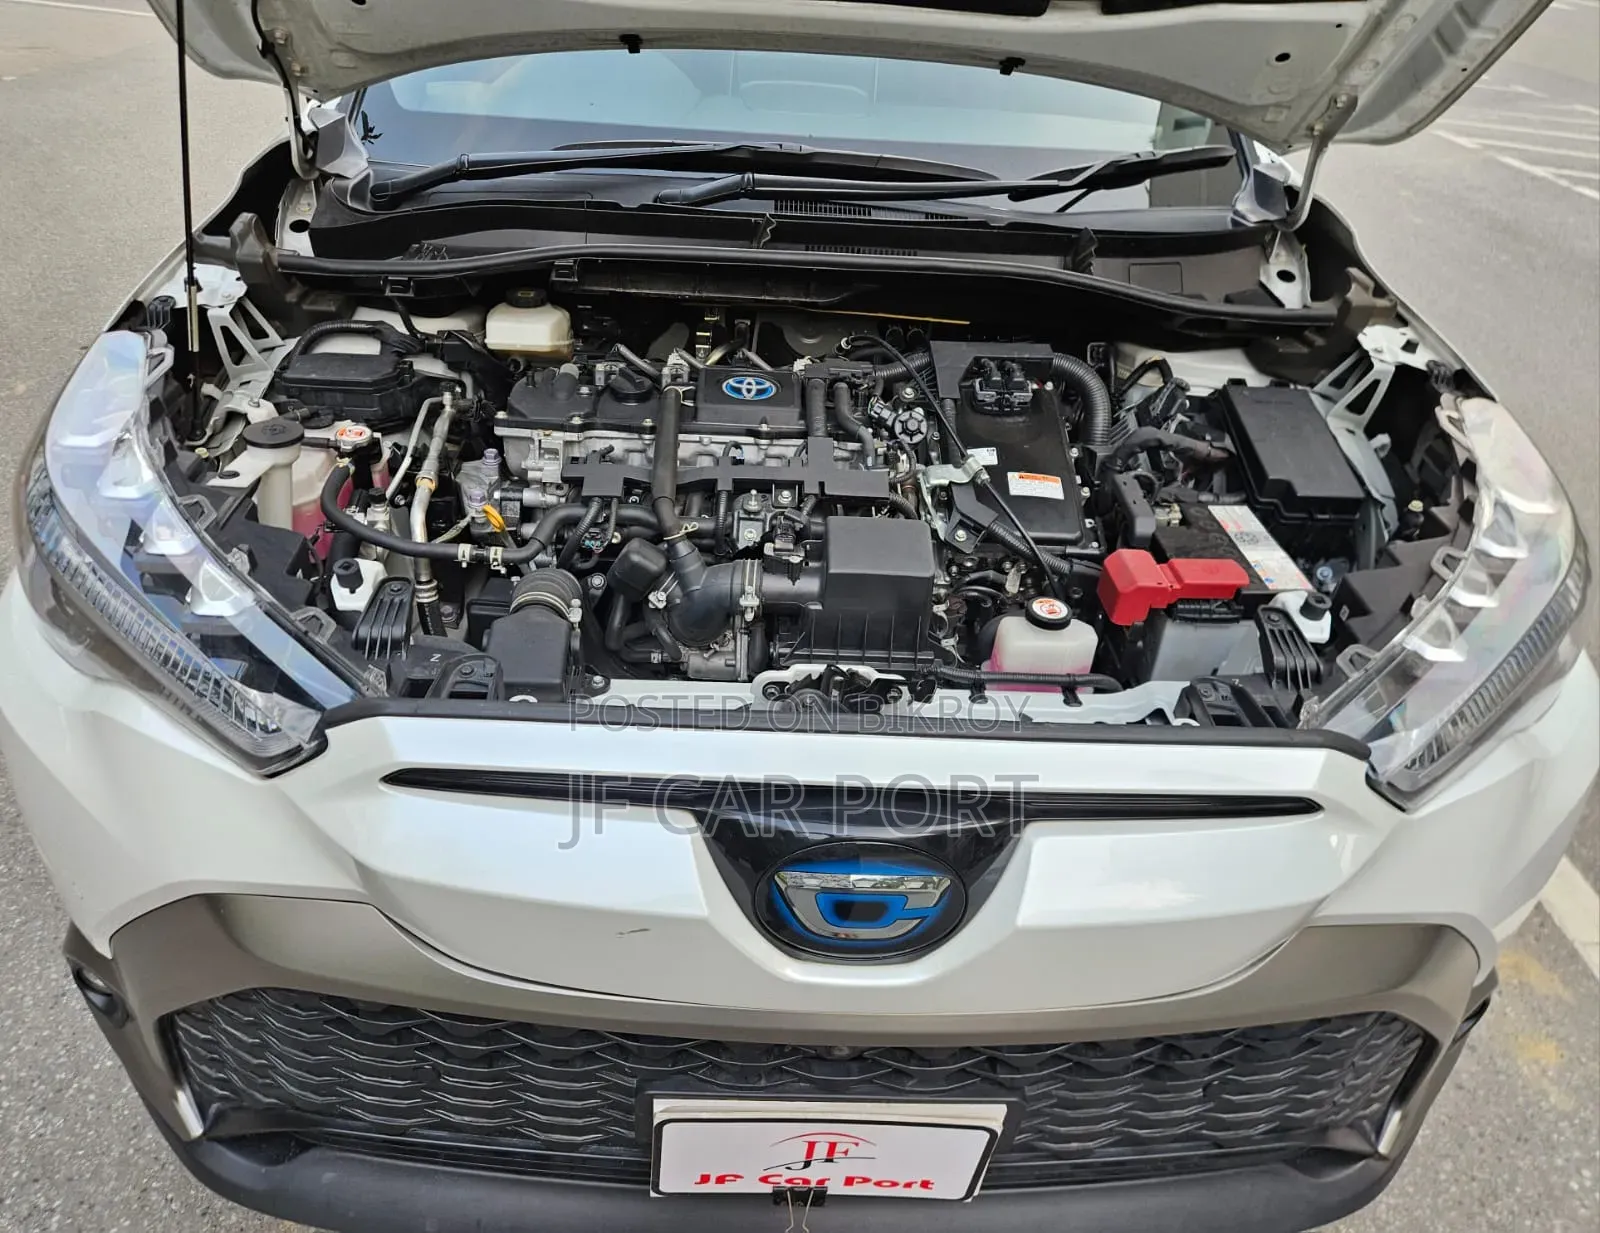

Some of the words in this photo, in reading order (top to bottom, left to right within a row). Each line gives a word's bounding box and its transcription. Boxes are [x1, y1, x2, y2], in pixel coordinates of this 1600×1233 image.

[785, 1140, 860, 1171] JF
[694, 1173, 744, 1186] JF
[758, 1173, 831, 1187] Car
[843, 1175, 936, 1191] Port
